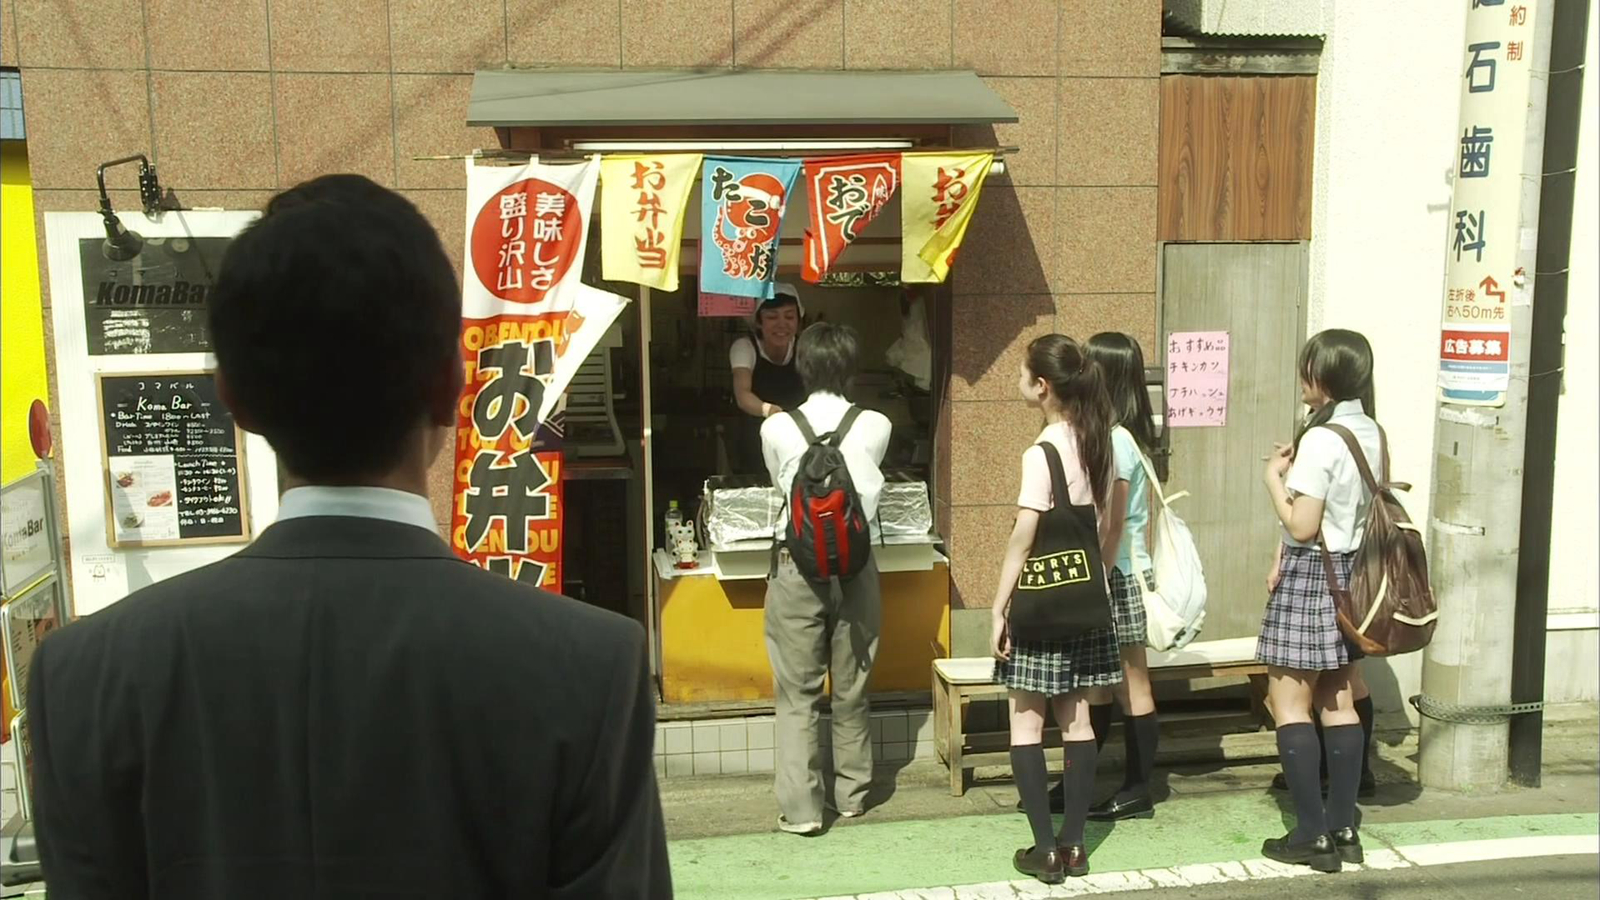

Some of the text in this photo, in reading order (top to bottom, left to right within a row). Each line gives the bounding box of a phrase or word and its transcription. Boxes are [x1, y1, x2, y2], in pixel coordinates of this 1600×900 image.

[1453, 0, 1505, 262] 石歯科
[497, 192, 528, 291] 盛り沢山
[531, 192, 566, 291] 美味しさ
[630, 161, 668, 270] お弁当
[1169, 338, 1226, 354] おすすめ品
[1444, 338, 1502, 356] 広告募集
[137, 395, 193, 412] Koma Bar
[1027, 567, 1079, 585] FARM
